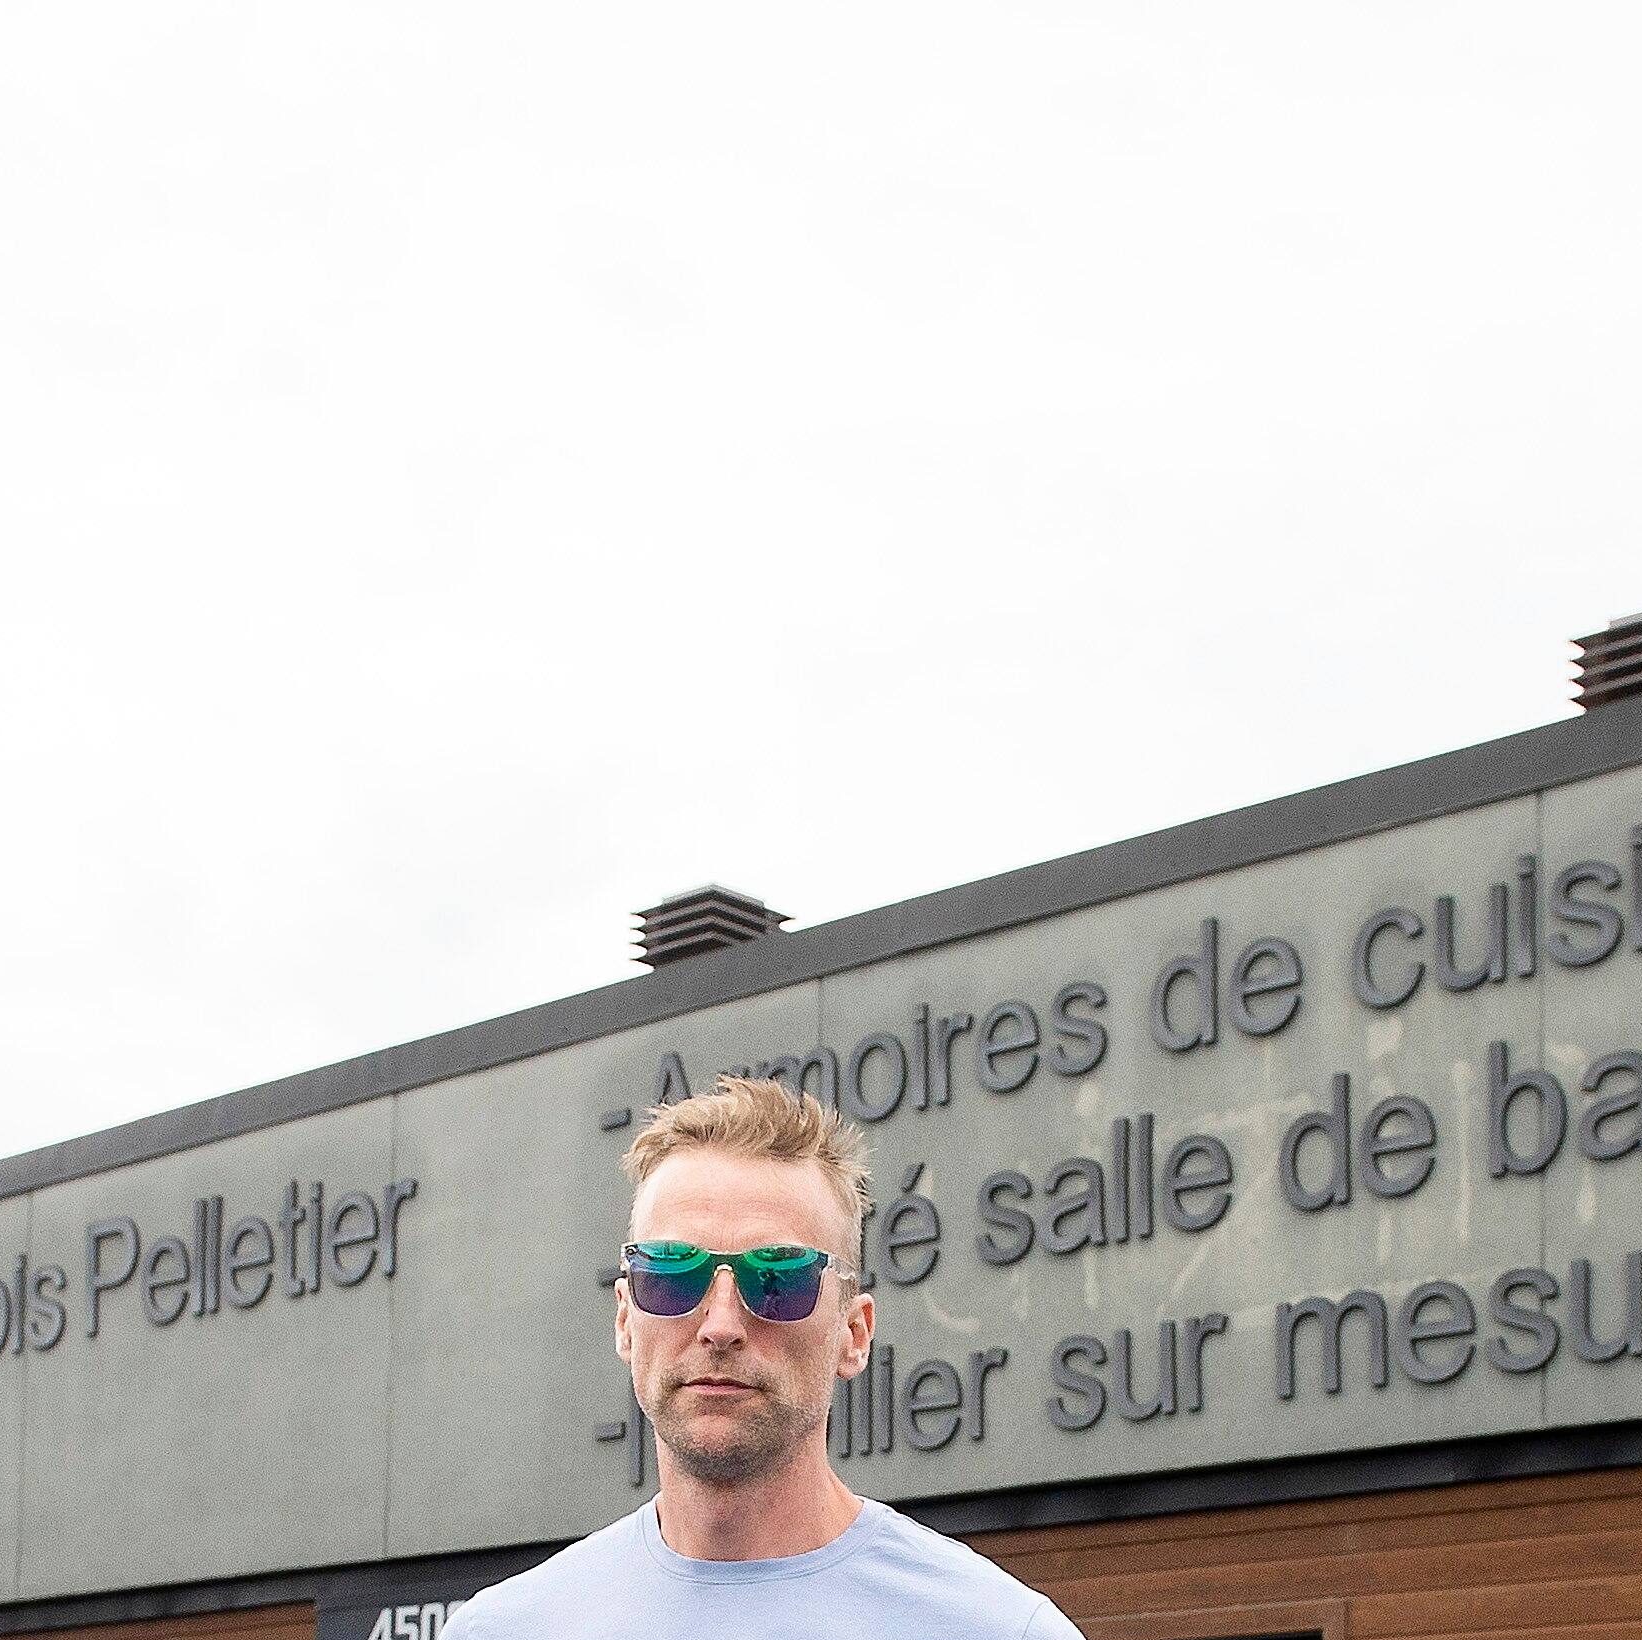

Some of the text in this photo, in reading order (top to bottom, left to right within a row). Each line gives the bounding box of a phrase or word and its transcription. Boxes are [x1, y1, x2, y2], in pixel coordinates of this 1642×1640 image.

[1152, 917, 1305, 1056] de
[977, 1112, 1235, 1268] salle
[1279, 1072, 1439, 1215] de
[86, 1178, 420, 1339] Pelletier
[1049, 1308, 1230, 1432] sur
